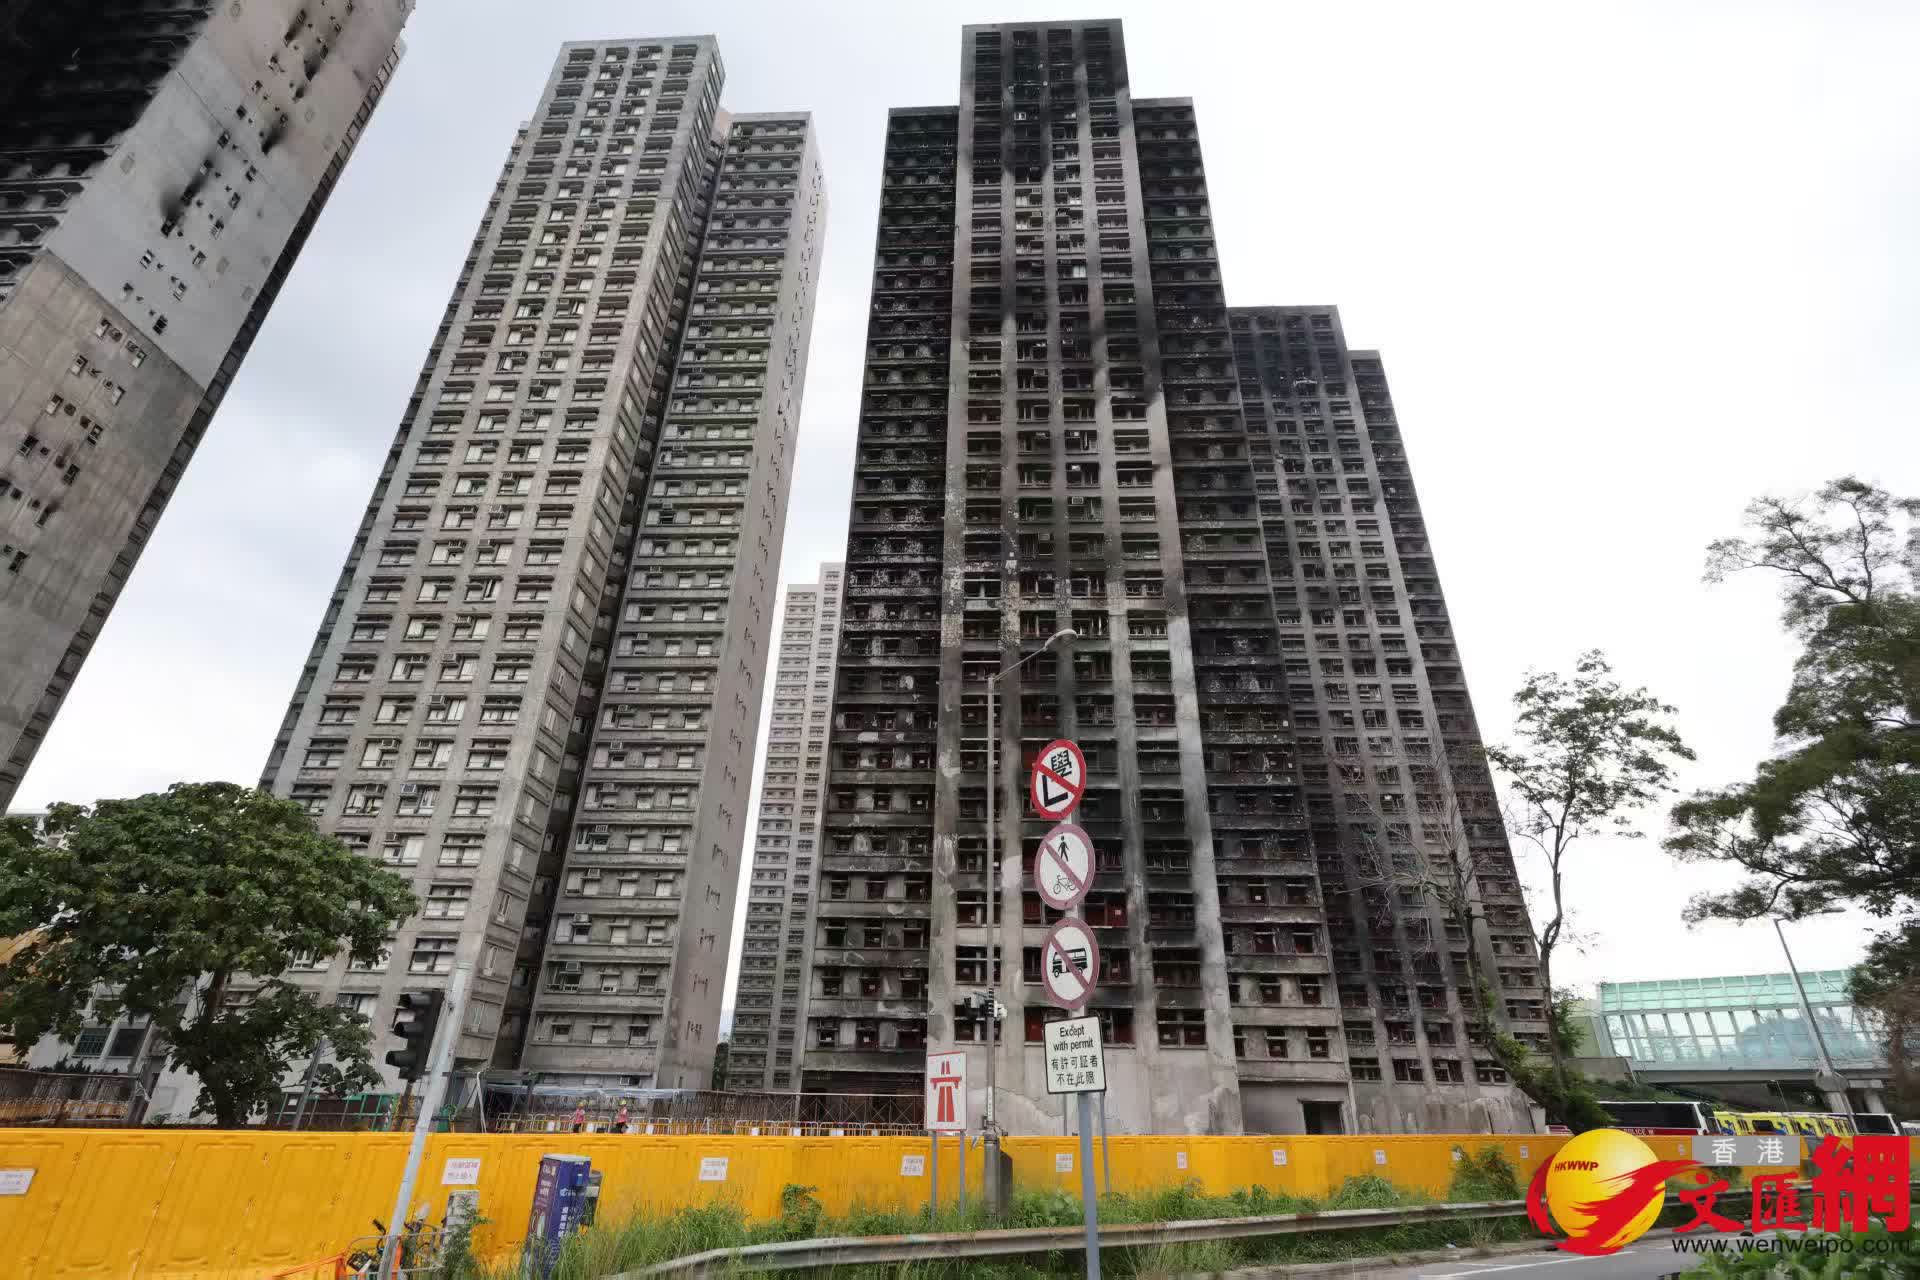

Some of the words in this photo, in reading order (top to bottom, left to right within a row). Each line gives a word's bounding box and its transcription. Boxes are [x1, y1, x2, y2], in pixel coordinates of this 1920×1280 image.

[1042, 775, 1068, 807] L
[1060, 1025, 1085, 1037] Except
[1053, 1041, 1068, 1051] with
[1070, 1038, 1094, 1052] permit
[1051, 1054, 1098, 1070] 有許可証者
[1056, 1071, 1095, 1086] 不在此限
